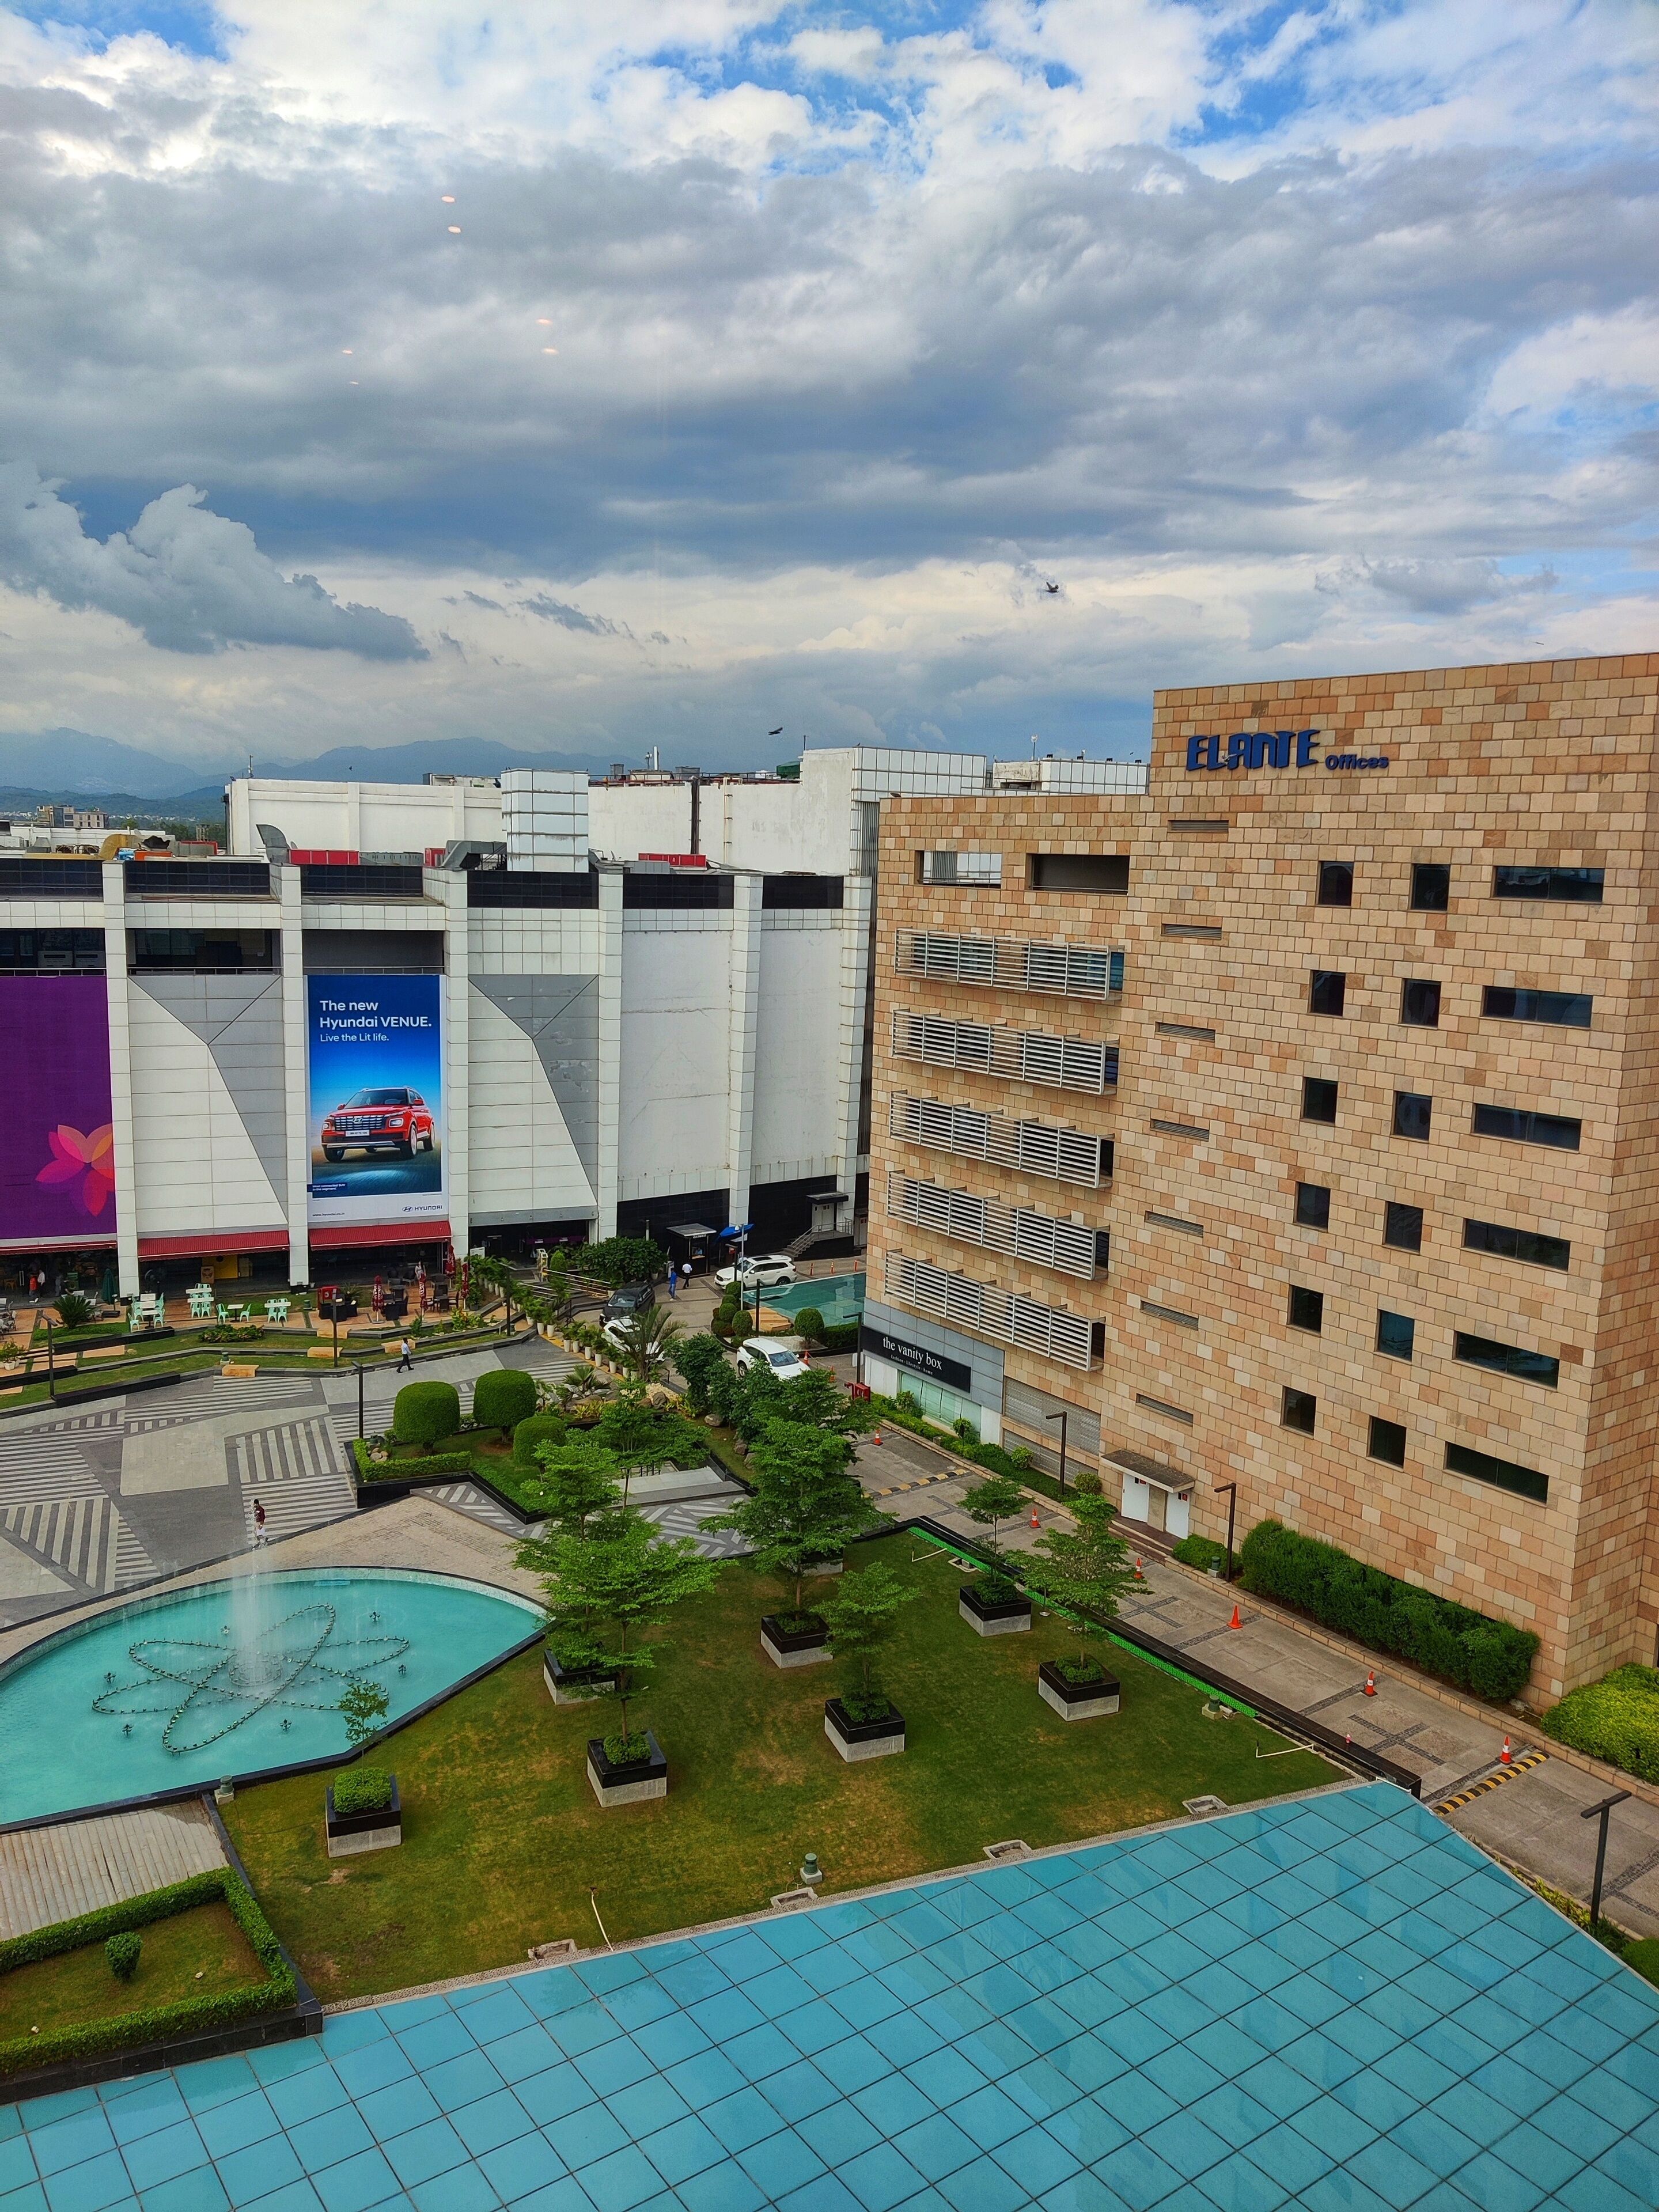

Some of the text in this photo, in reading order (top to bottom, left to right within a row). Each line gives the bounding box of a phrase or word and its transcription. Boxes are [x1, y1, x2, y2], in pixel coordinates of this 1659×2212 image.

[1186, 729, 1389, 771] ELANTE Offices
[320, 1000, 378, 1011] The new
[320, 1016, 432, 1030] Hyundai VENUE.
[320, 1033, 389, 1041] Live the Lit life.
[882, 1336, 942, 1370] the vanity box
[891, 1354, 933, 1376] fashion lifestyle home
